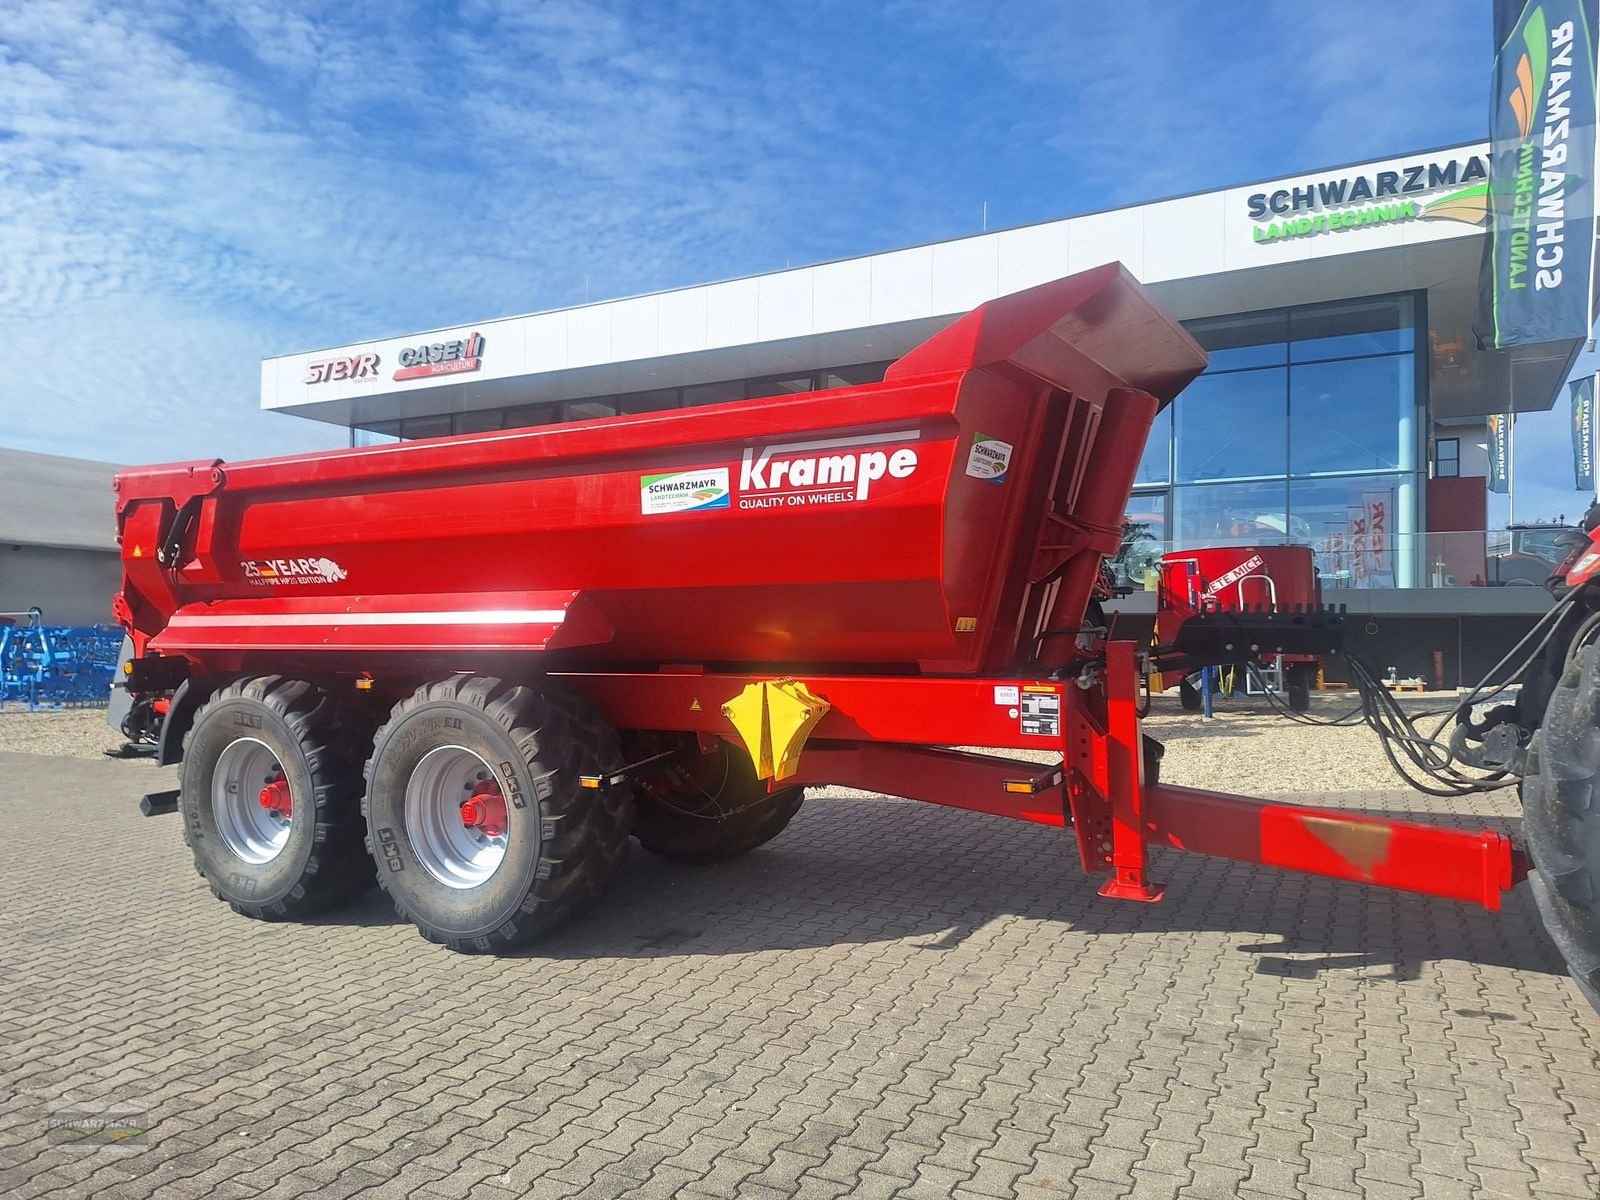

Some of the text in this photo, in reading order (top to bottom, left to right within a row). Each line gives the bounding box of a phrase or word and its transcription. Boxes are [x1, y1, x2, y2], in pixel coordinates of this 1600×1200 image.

[1253, 200, 1416, 242] LANDTECHNIK
[303, 352, 380, 384] STEYR
[431, 360, 475, 375] AGRICULTURE
[739, 443, 919, 501] Krampe
[648, 479, 716, 494] SCHWARZMAYR
[650, 493, 689, 501] LANDTECHNIK
[739, 492, 854, 510] QUALITY ON WHEELS
[240, 558, 320, 577] 25 YEARS
[297, 575, 327, 585] EDITION
[1207, 555, 1263, 595] IETE MICH
[499, 761, 527, 809] BKT
[377, 827, 404, 872] BKT
